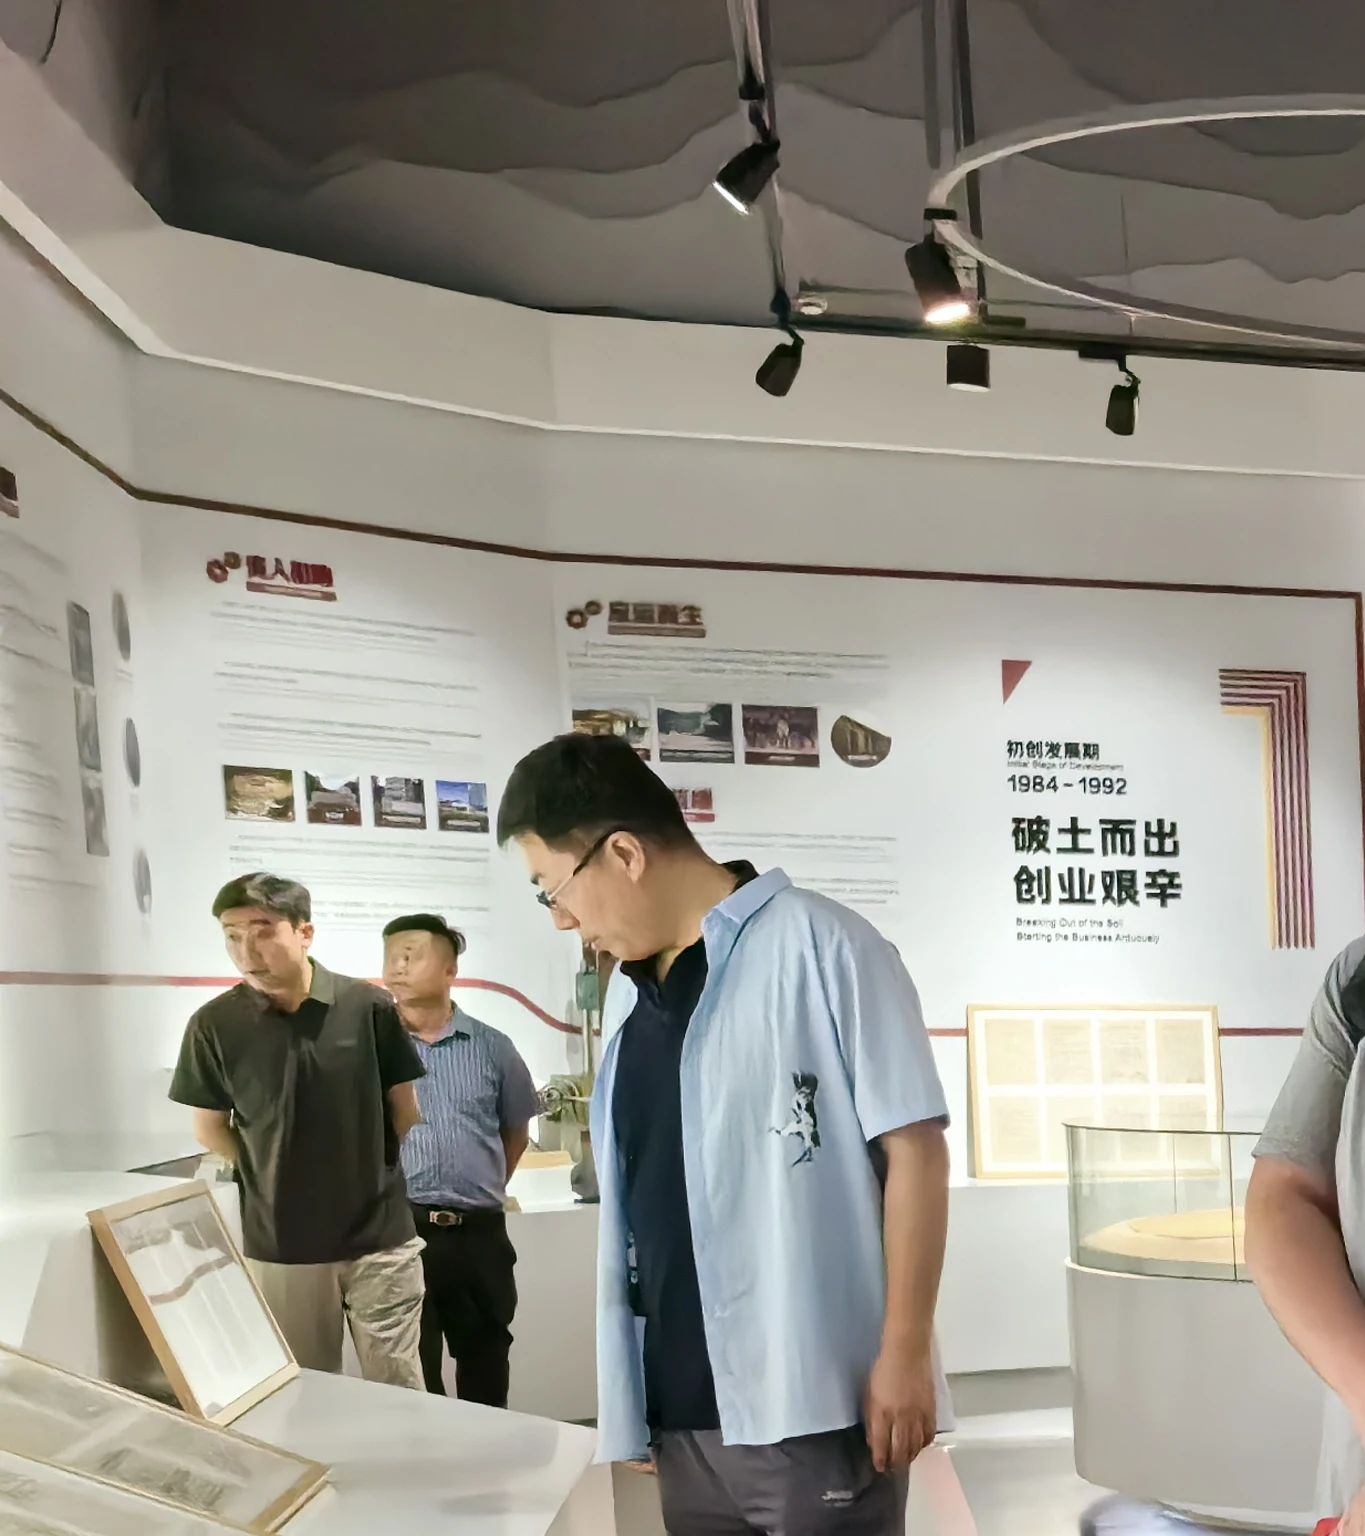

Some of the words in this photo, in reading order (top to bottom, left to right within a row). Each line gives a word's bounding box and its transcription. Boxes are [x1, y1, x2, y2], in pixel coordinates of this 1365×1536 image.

[1007, 740, 1100, 760] 初创发展期
[1011, 815, 1180, 858] 破土而出
[1013, 864, 1183, 908] 创业艰辛
[1059, 917, 1076, 927] Out
[1079, 917, 1088, 927] of
[1090, 917, 1103, 927] the
[1055, 932, 1068, 940] the
[1072, 932, 1112, 942] Business
